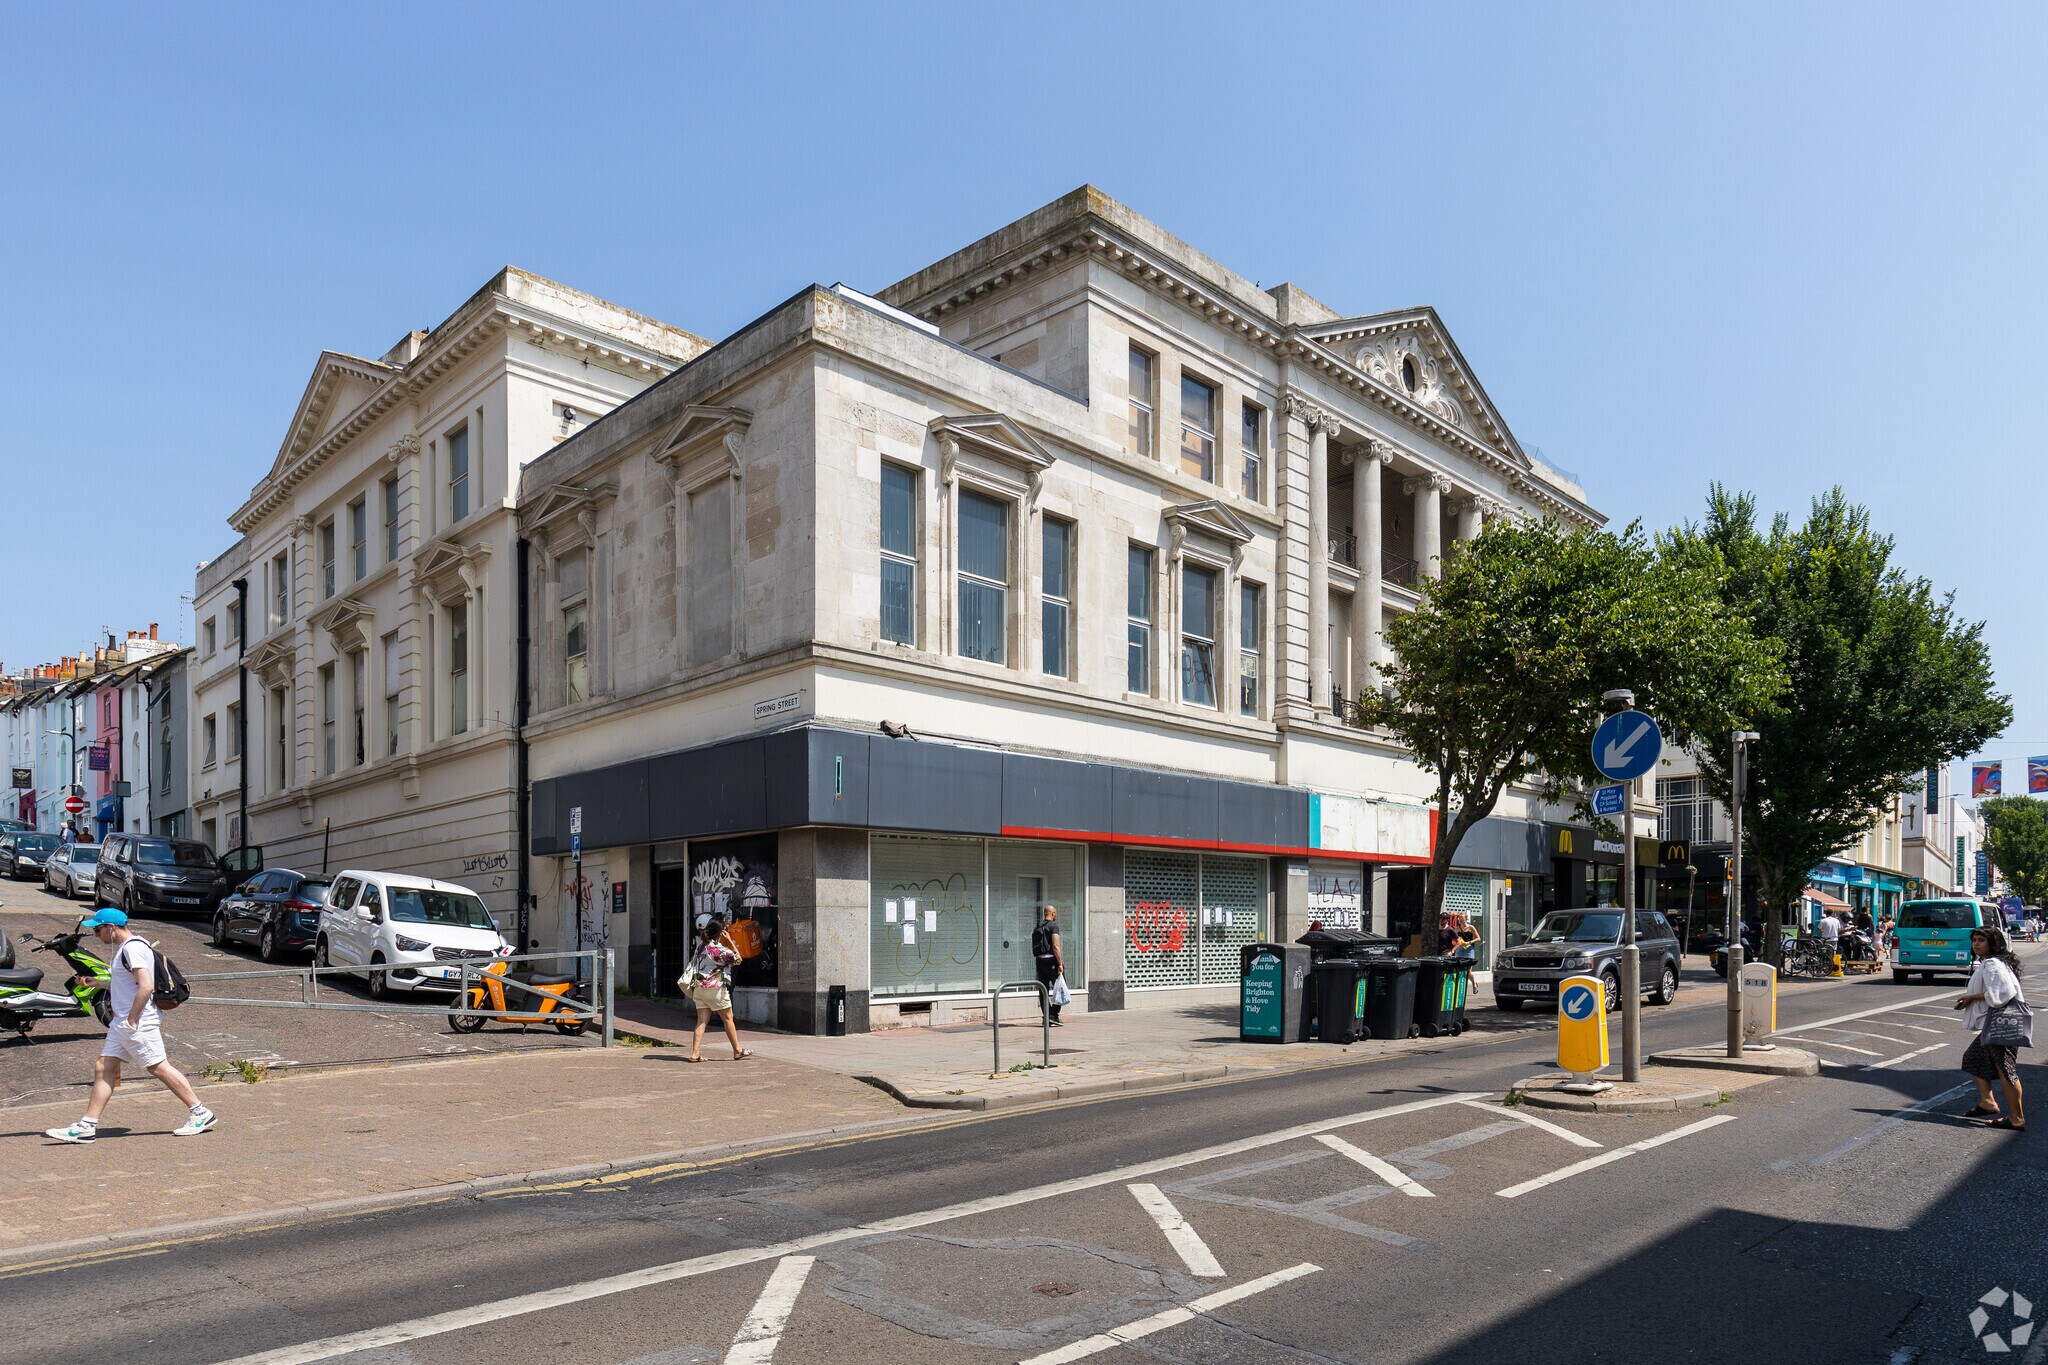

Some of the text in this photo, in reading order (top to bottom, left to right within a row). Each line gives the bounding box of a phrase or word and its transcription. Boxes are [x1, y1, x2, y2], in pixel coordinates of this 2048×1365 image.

[756, 697, 799, 715] SPRING STREET
[1605, 799, 1618, 807] School
[573, 836, 579, 849] P
[1245, 979, 1273, 989] Keeping
[1245, 988, 1275, 997] Brighton
[1251, 996, 1269, 1004] Hove
[1245, 1005, 1260, 1014] Tidy
[1996, 1016, 2018, 1026] one
